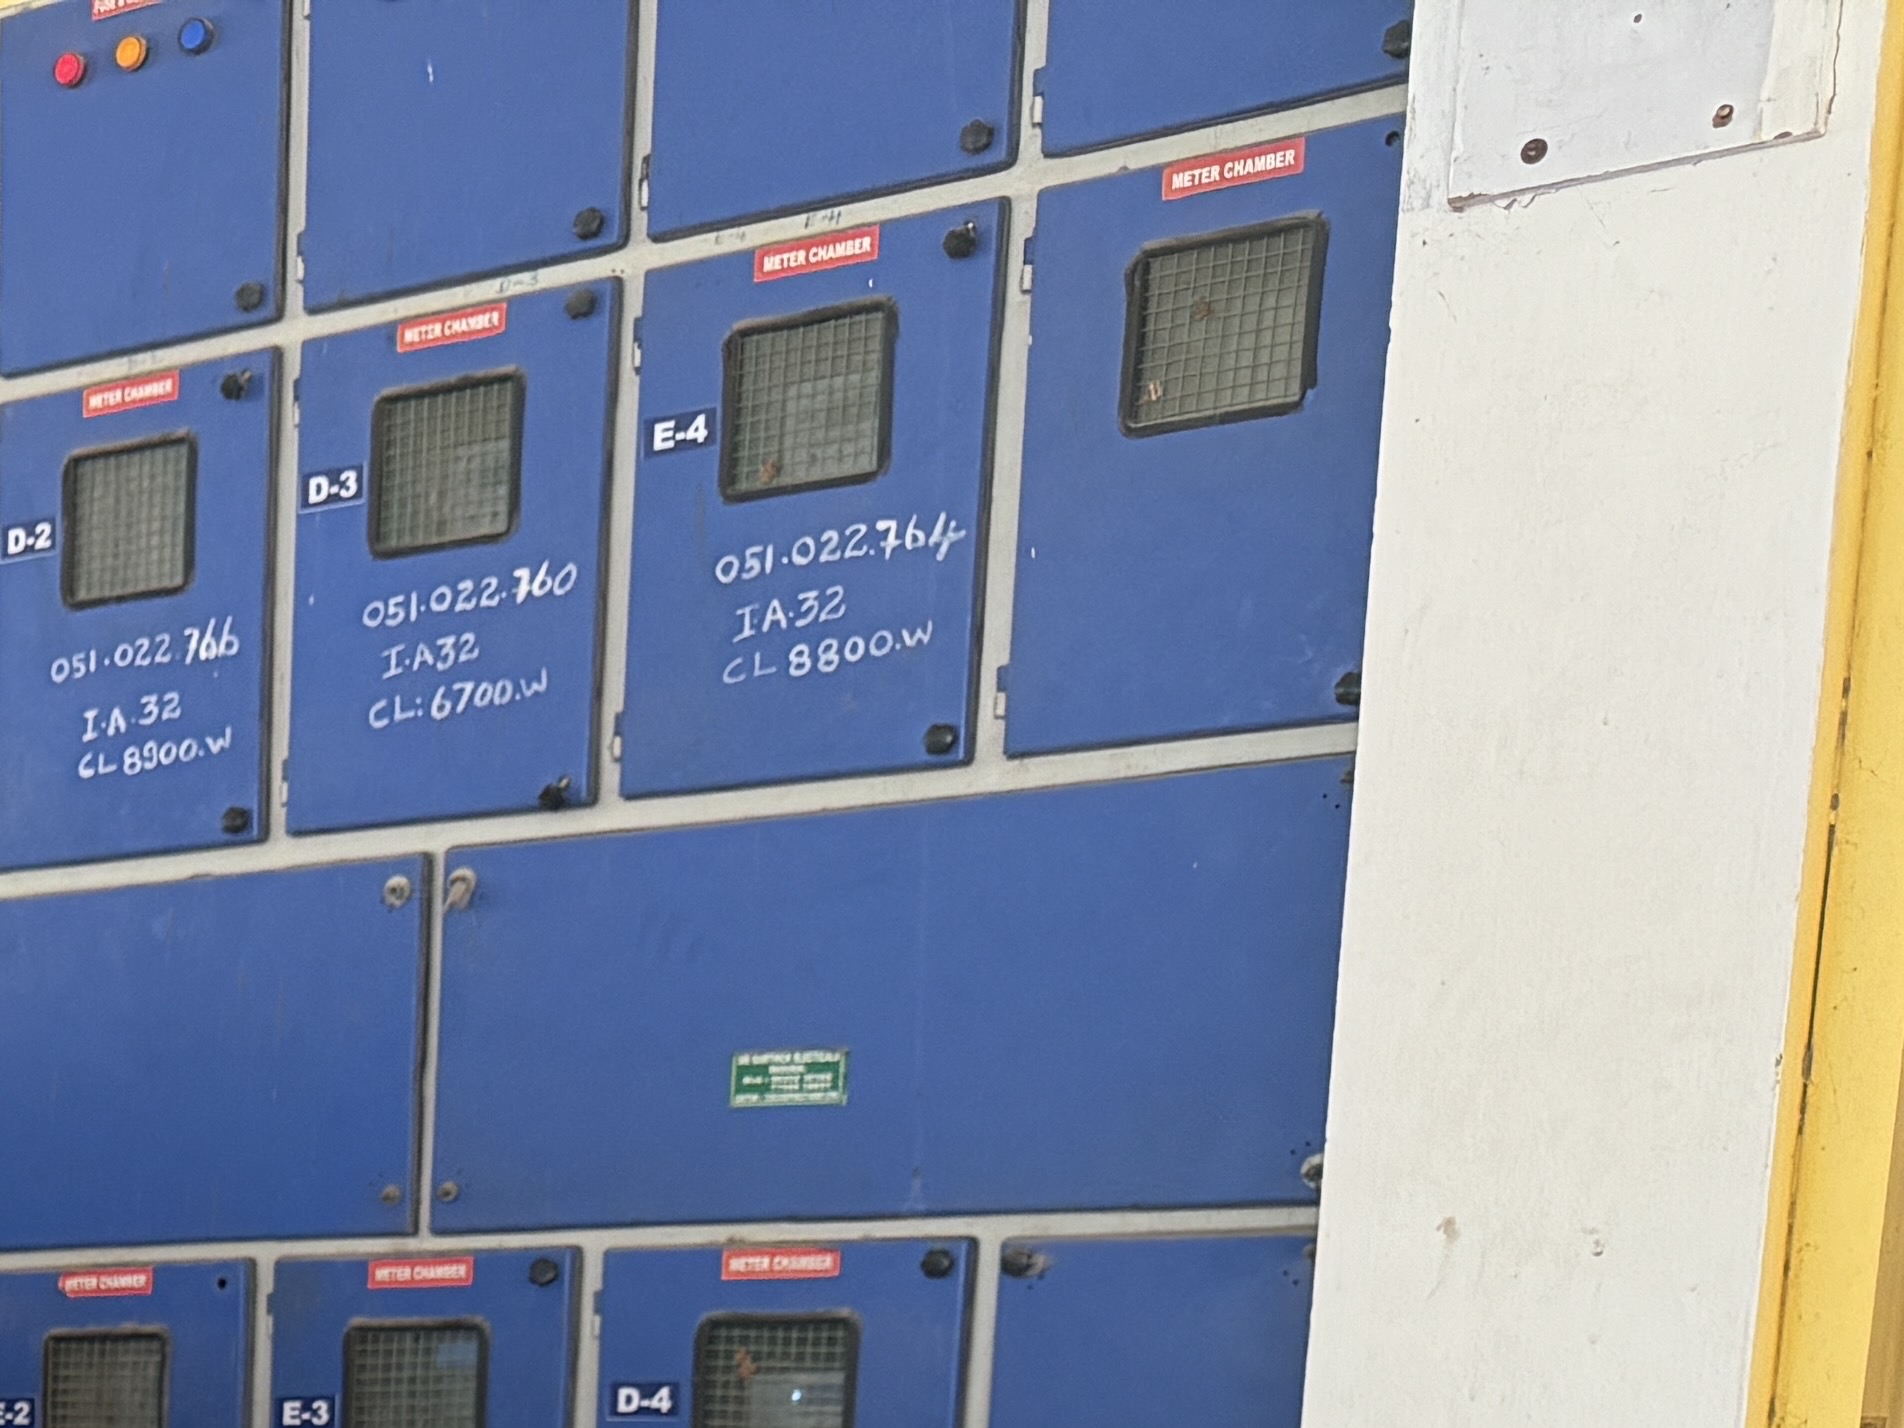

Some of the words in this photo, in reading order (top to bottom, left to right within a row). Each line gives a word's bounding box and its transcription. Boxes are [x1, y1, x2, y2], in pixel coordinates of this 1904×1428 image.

[1172, 162, 1221, 190] METER
[1224, 149, 1296, 180] CHAMBER
[763, 247, 806, 273] METER
[808, 236, 872, 264] CHAMBER
[403, 320, 442, 345] METER
[444, 309, 500, 337] CHAMBER
[88, 386, 122, 410] METER
[123, 376, 175, 403] CHAMBER
[653, 413, 709, 451] E-4
[309, 470, 359, 505] D-3
[8, 522, 52, 555] D-2
[374, 1266, 412, 1284] METER
[413, 1263, 468, 1283] CHAMBER
[282, 1402, 330, 1427] E-3
[617, 1386, 673, 1414] D-4
